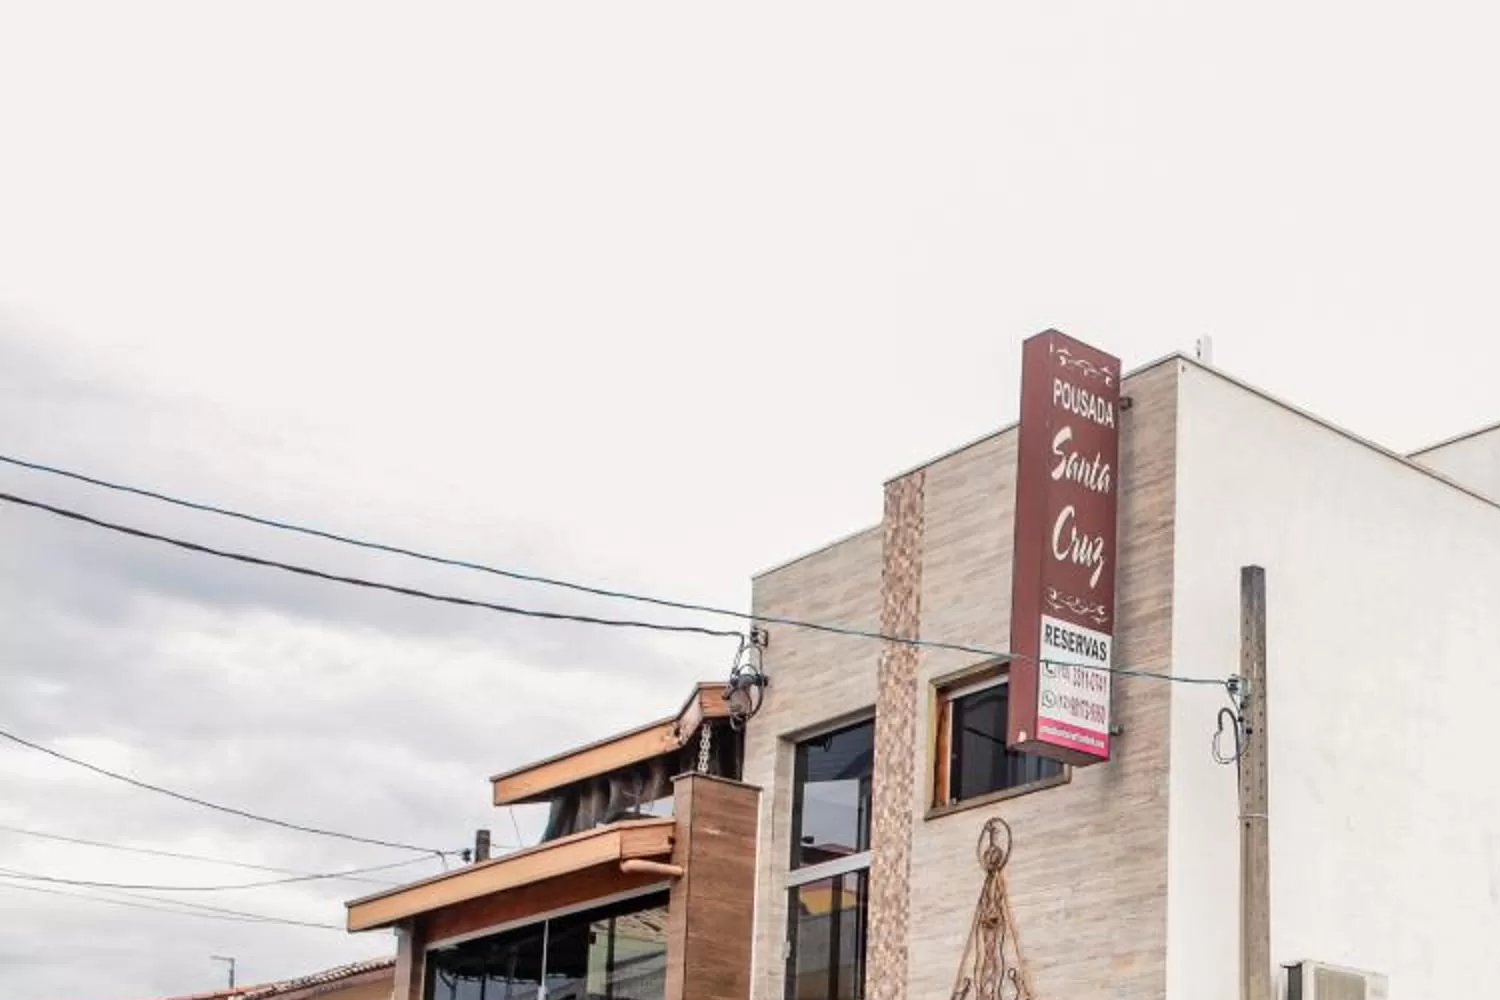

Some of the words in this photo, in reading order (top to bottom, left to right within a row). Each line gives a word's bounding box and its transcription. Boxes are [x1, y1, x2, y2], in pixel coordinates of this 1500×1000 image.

[1053, 379, 1115, 429] POUSADA
[1052, 426, 1111, 493] Santa
[1052, 505, 1105, 588] Cruz
[1044, 624, 1107, 661] RESERVAS
